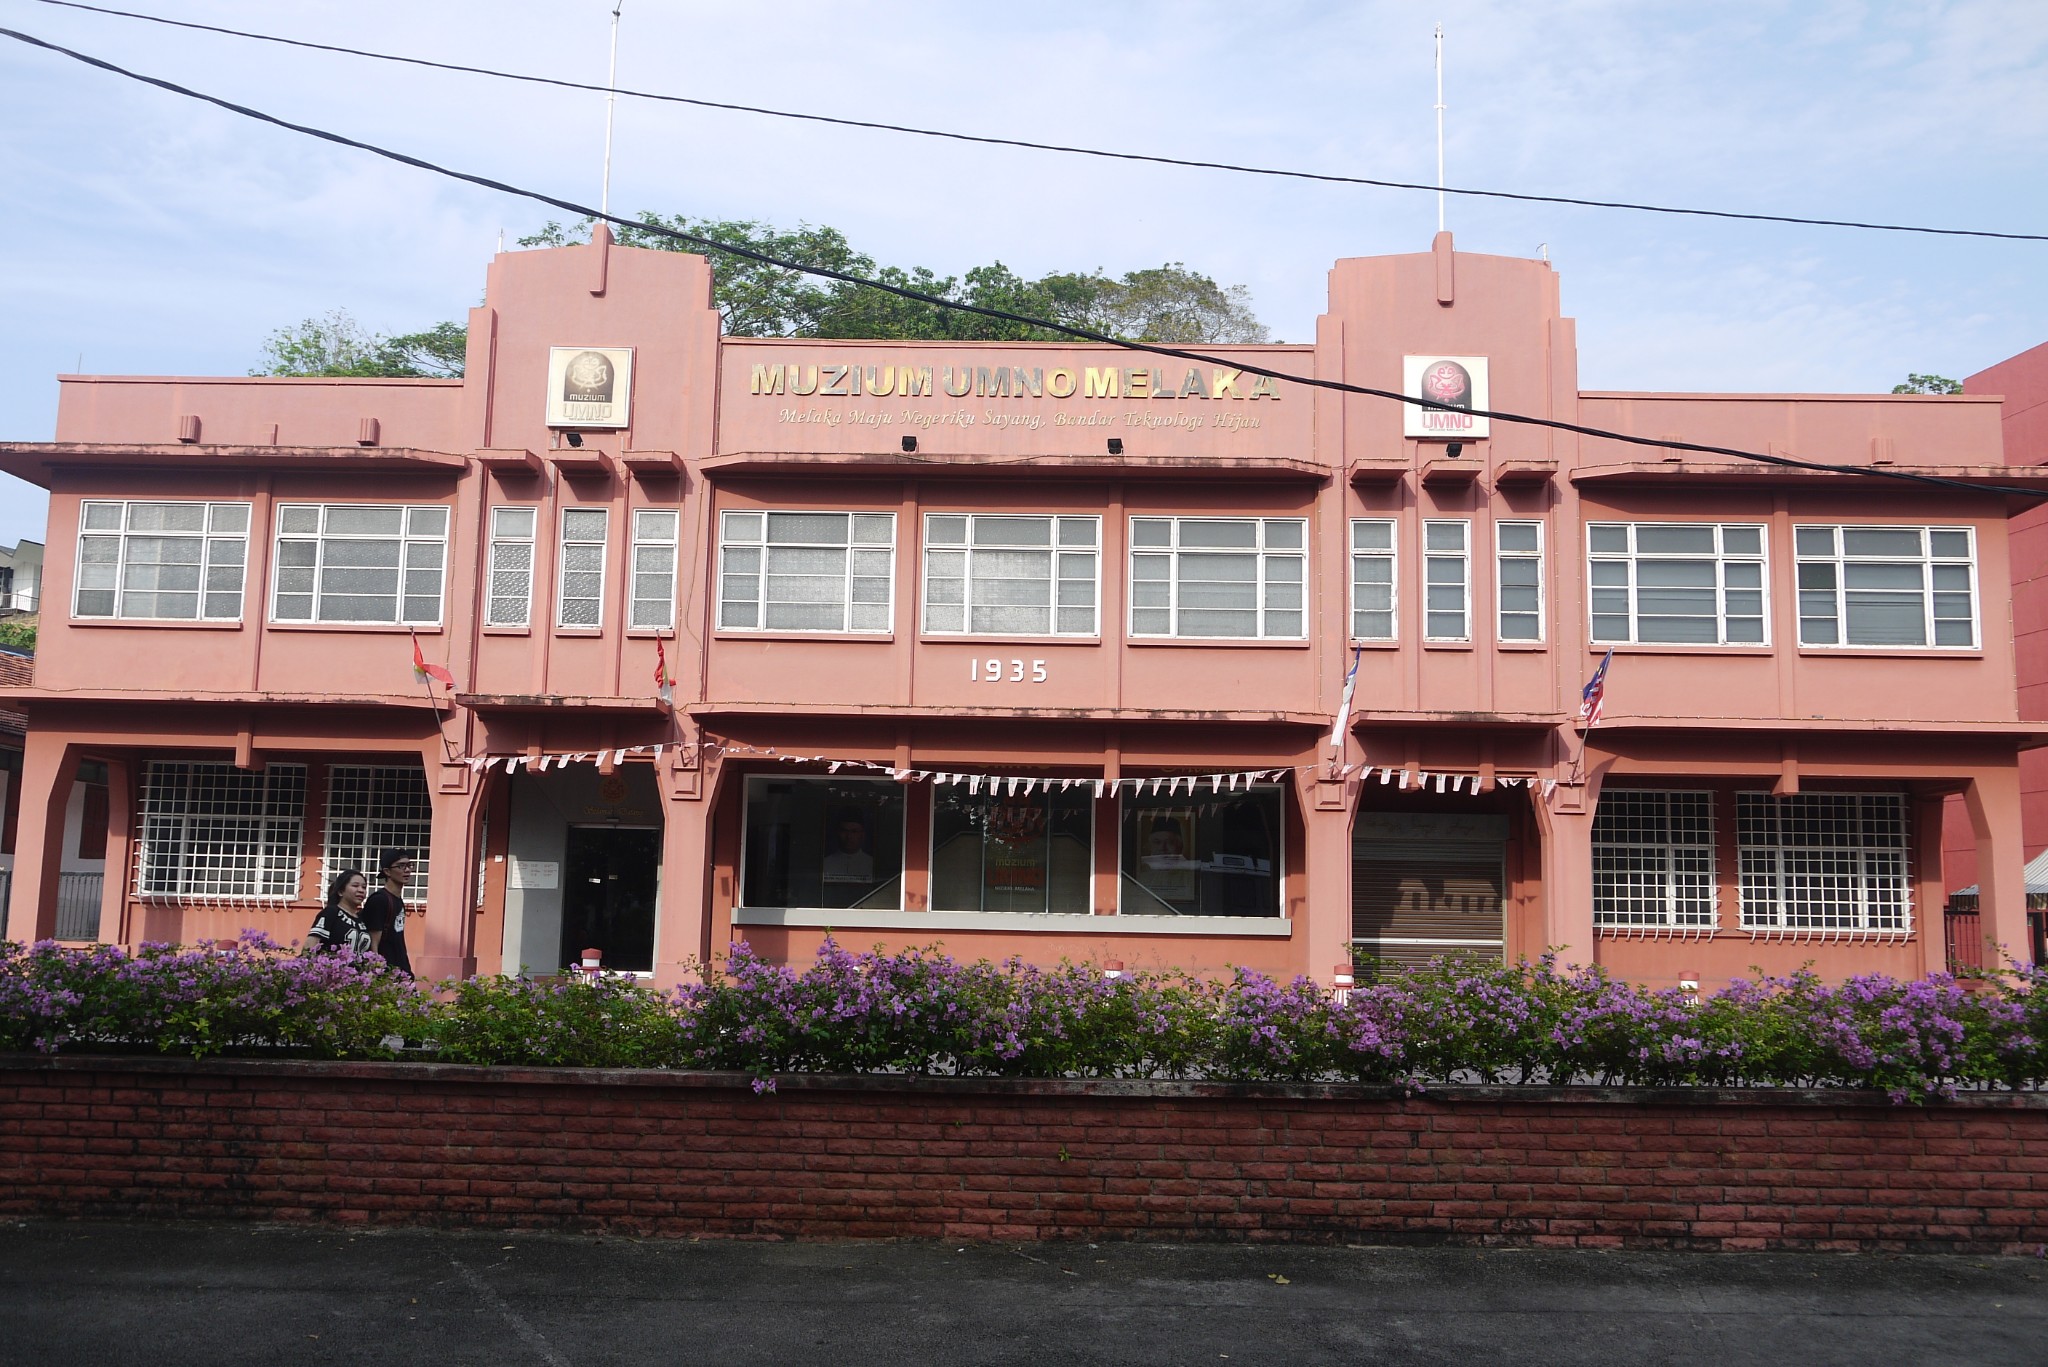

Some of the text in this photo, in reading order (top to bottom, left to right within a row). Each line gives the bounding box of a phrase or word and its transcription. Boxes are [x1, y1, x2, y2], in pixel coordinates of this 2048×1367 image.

[751, 363, 1281, 400] MUZIUM UMNO MELAKA
[563, 403, 613, 418] UMNO
[779, 408, 1261, 432] Melaka Maju Negeriku Sayang, Bandar Teknologi Hijau
[1422, 413, 1473, 429] UMNO
[971, 658, 1047, 683] 1935
